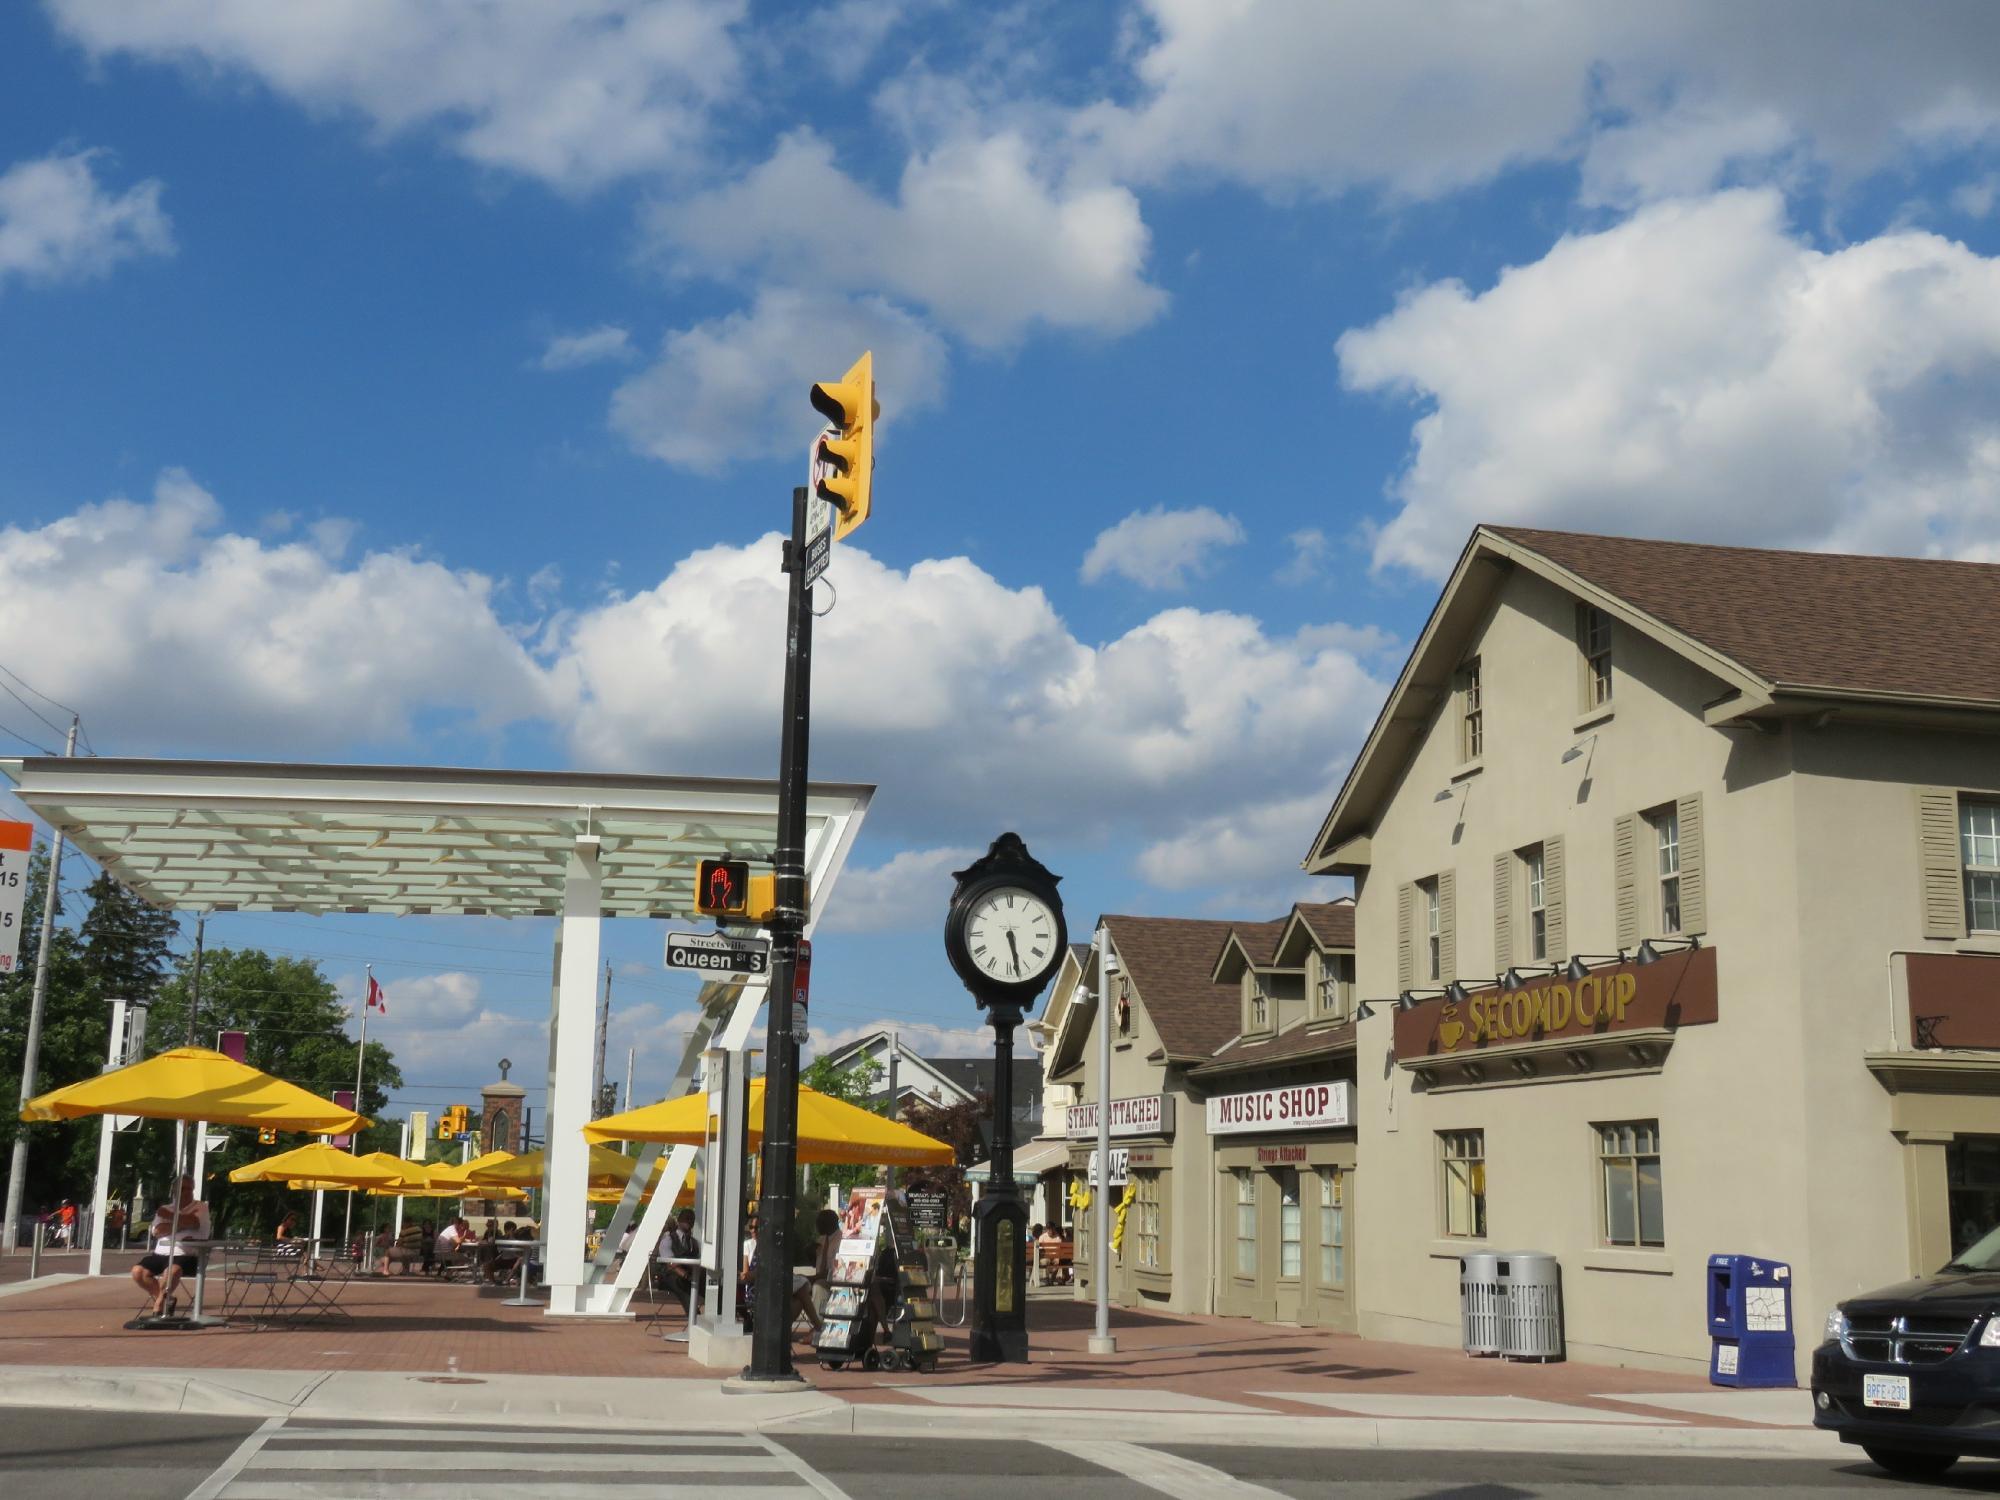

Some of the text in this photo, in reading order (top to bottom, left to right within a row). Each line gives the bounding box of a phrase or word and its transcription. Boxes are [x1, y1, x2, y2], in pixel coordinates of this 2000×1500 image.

[811, 538, 826, 561] BUSES
[807, 552, 829, 581] EXCEPTED
[690, 937, 746, 950] Streetsville
[672, 948, 761, 971] Queen St S
[1469, 973, 1636, 1043] SECOND CUP
[1220, 1087, 1329, 1123] MUSIC SHOP
[1258, 1145, 1306, 1163] Strings Attached
[1715, 1257, 1729, 1265] FREE
